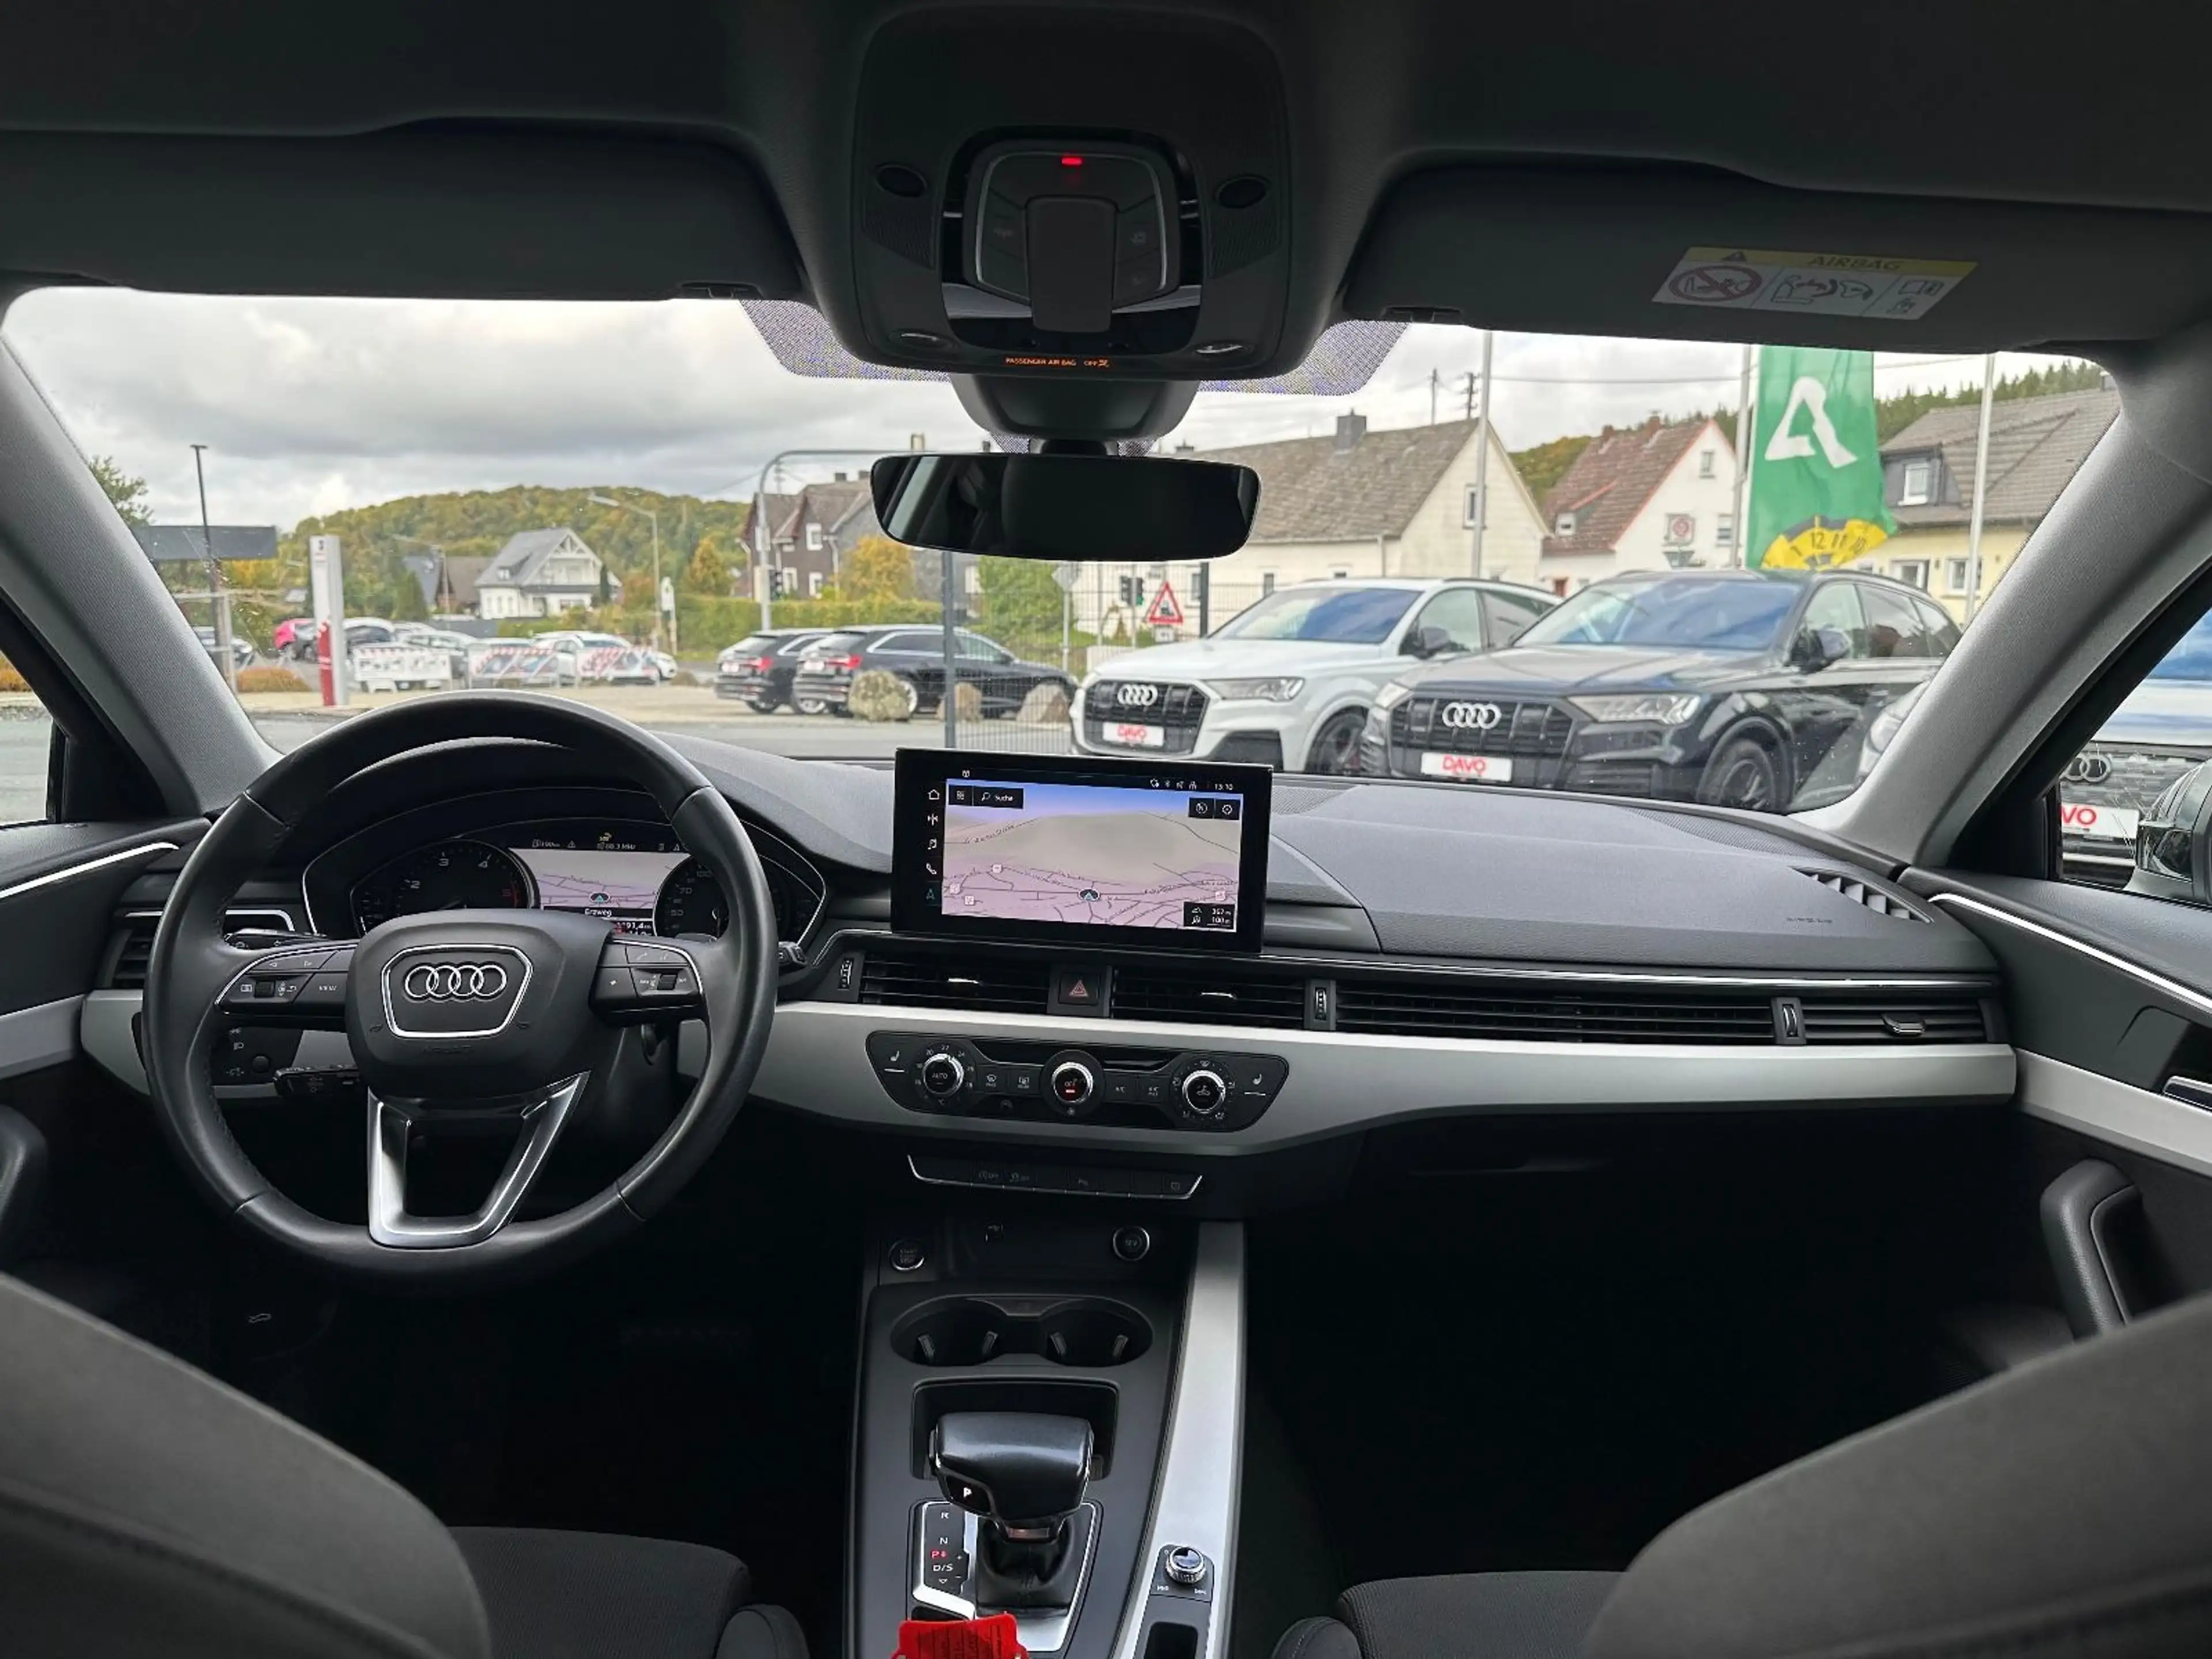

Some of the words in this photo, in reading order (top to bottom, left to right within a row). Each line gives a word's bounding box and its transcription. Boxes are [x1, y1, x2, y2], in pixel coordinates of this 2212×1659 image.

[1808, 256, 1900, 270] AIRBAG
[1810, 532, 1825, 550] 12
[1118, 725, 1147, 738] DAVO
[1442, 753, 1486, 772] DAVO
[439, 858, 449, 867] 3
[478, 861, 488, 869] 4
[410, 880, 421, 889] 2
[964, 1487, 972, 1498] P
[933, 1563, 953, 1571] D/S
